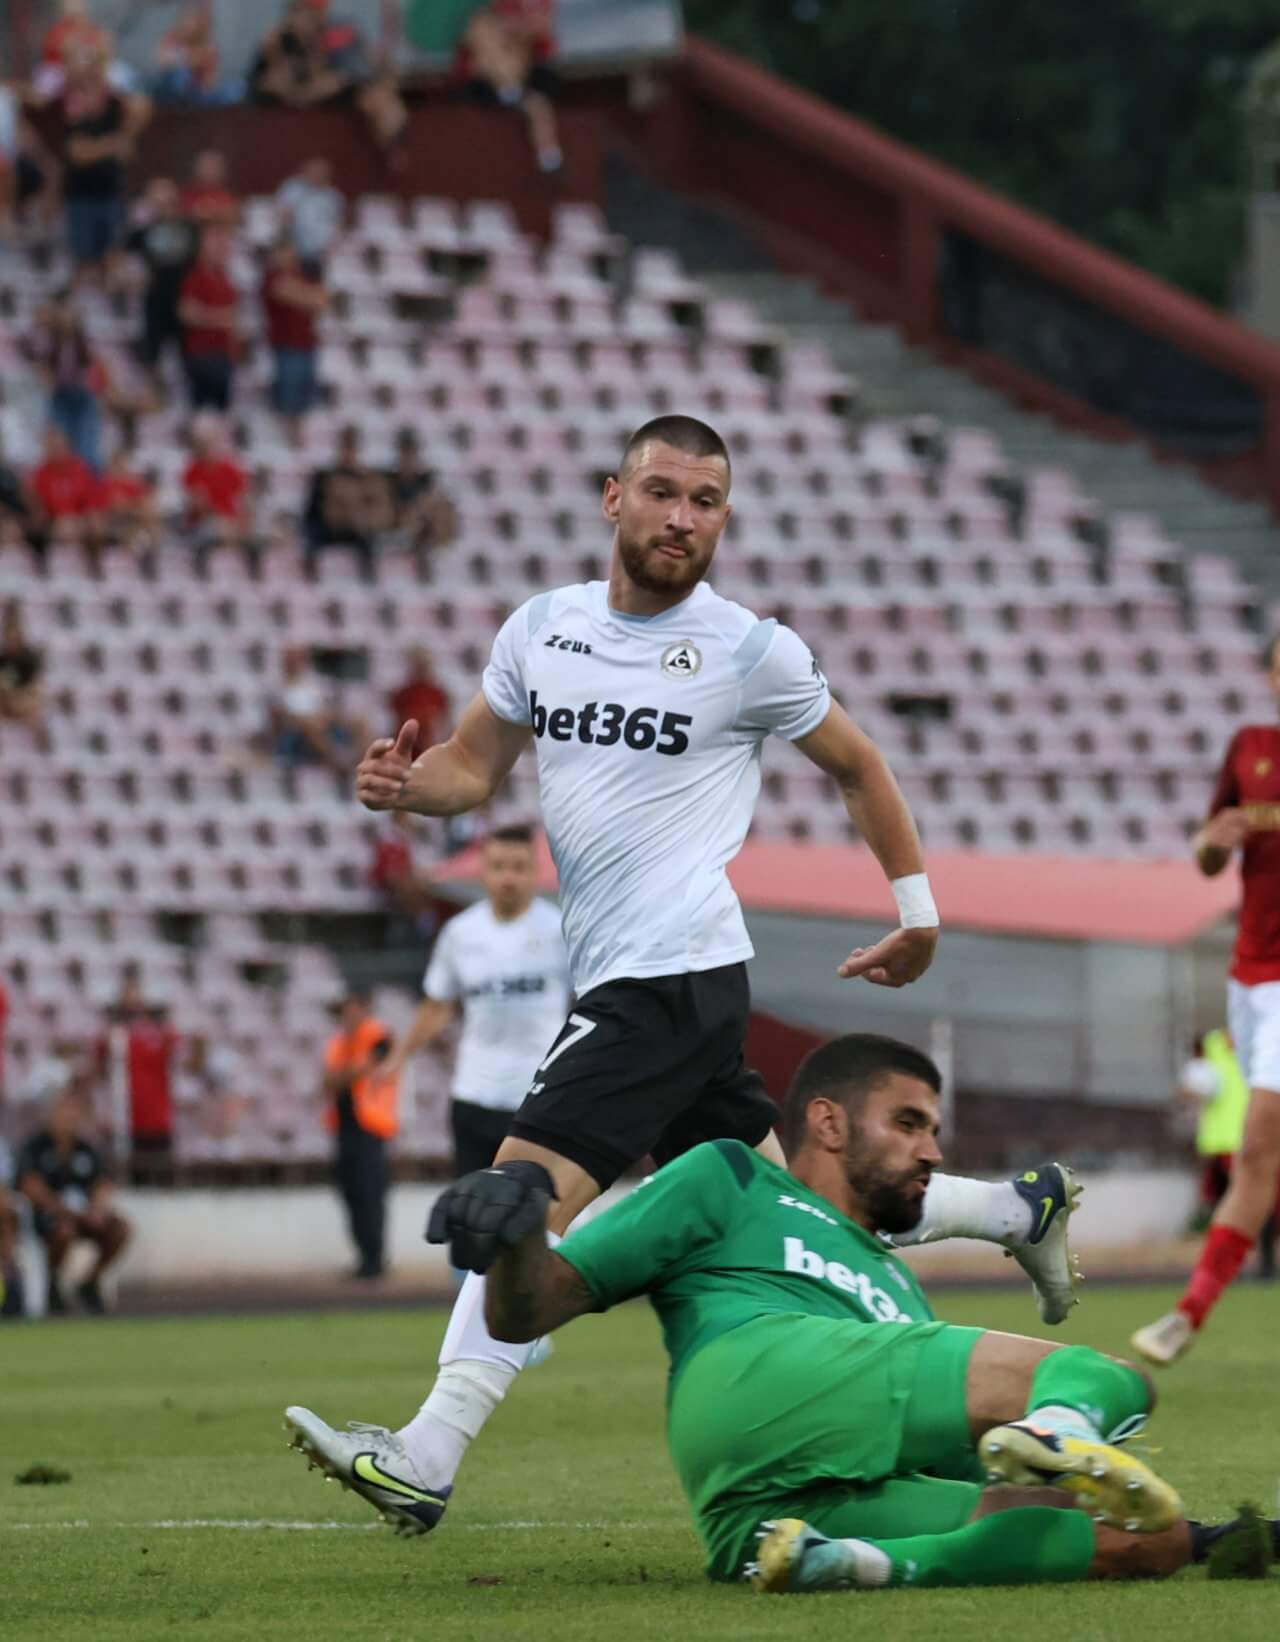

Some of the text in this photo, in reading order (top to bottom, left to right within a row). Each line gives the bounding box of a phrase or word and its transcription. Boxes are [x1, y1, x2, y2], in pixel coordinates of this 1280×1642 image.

[544, 634, 593, 655] Zeus
[529, 690, 693, 756] bet365
[538, 1012, 598, 1072] 7
[783, 1236, 913, 1324] bet3
